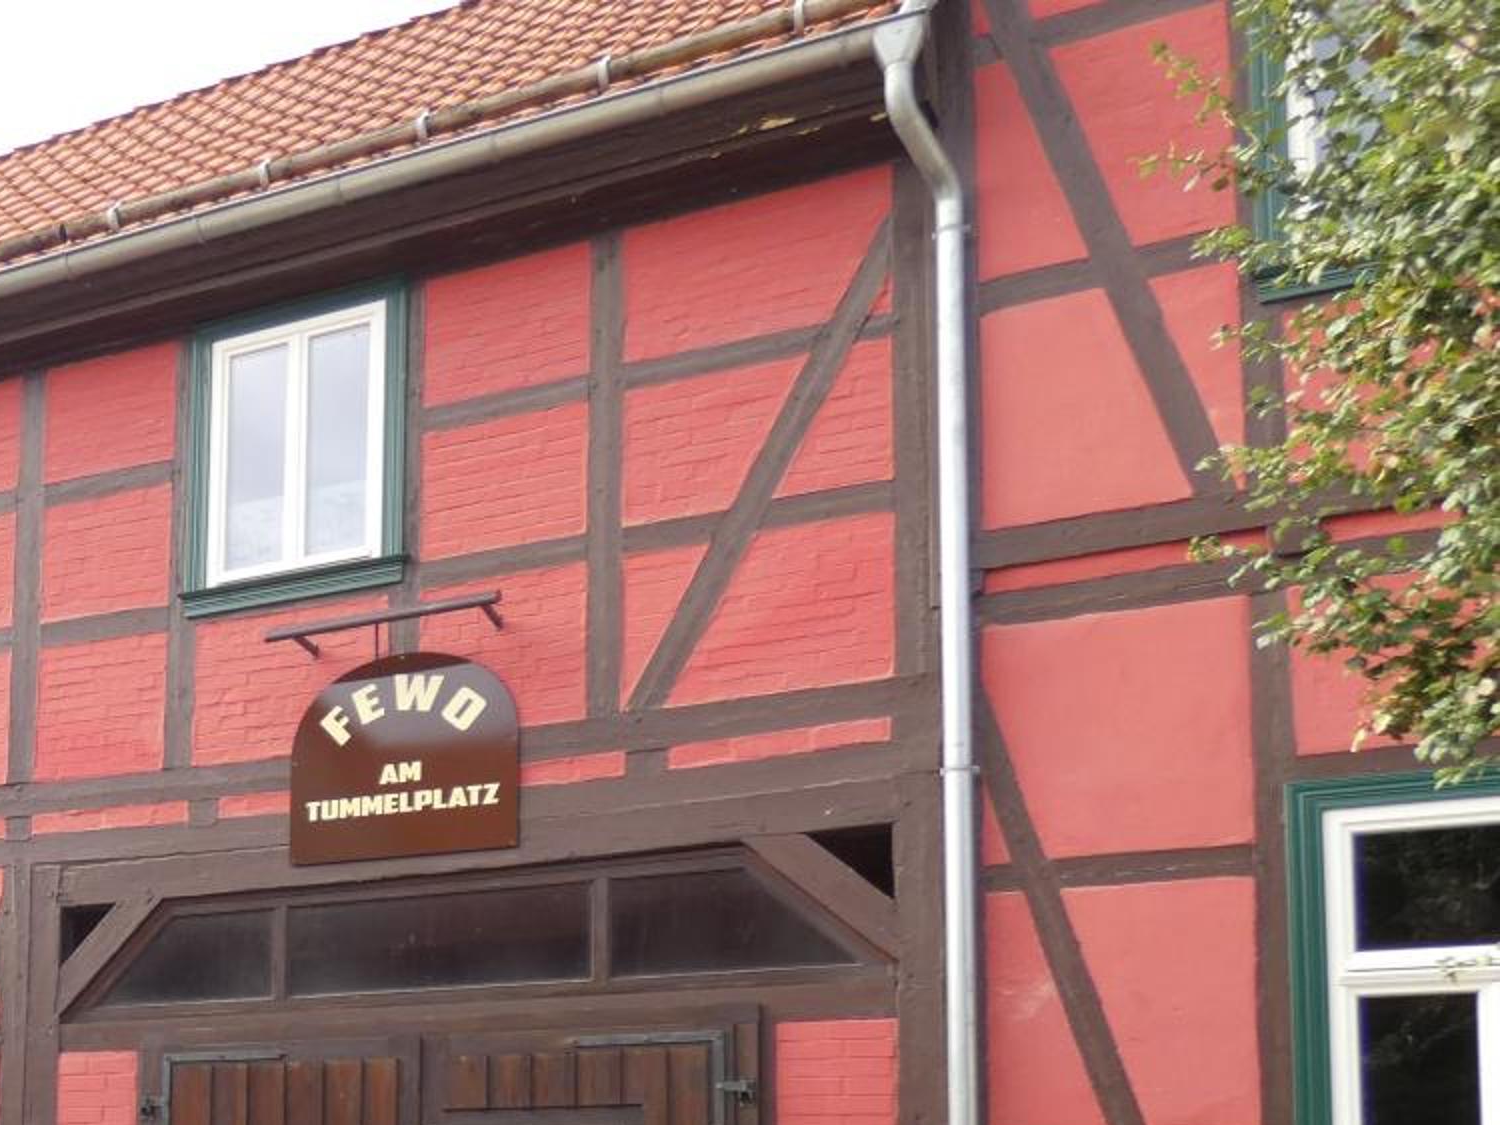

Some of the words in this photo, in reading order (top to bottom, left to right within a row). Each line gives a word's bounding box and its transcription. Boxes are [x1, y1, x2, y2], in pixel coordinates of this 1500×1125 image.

[320, 673, 488, 746] FEWO
[379, 761, 422, 785] AM
[306, 782, 501, 822] TUMMELPLATZ
